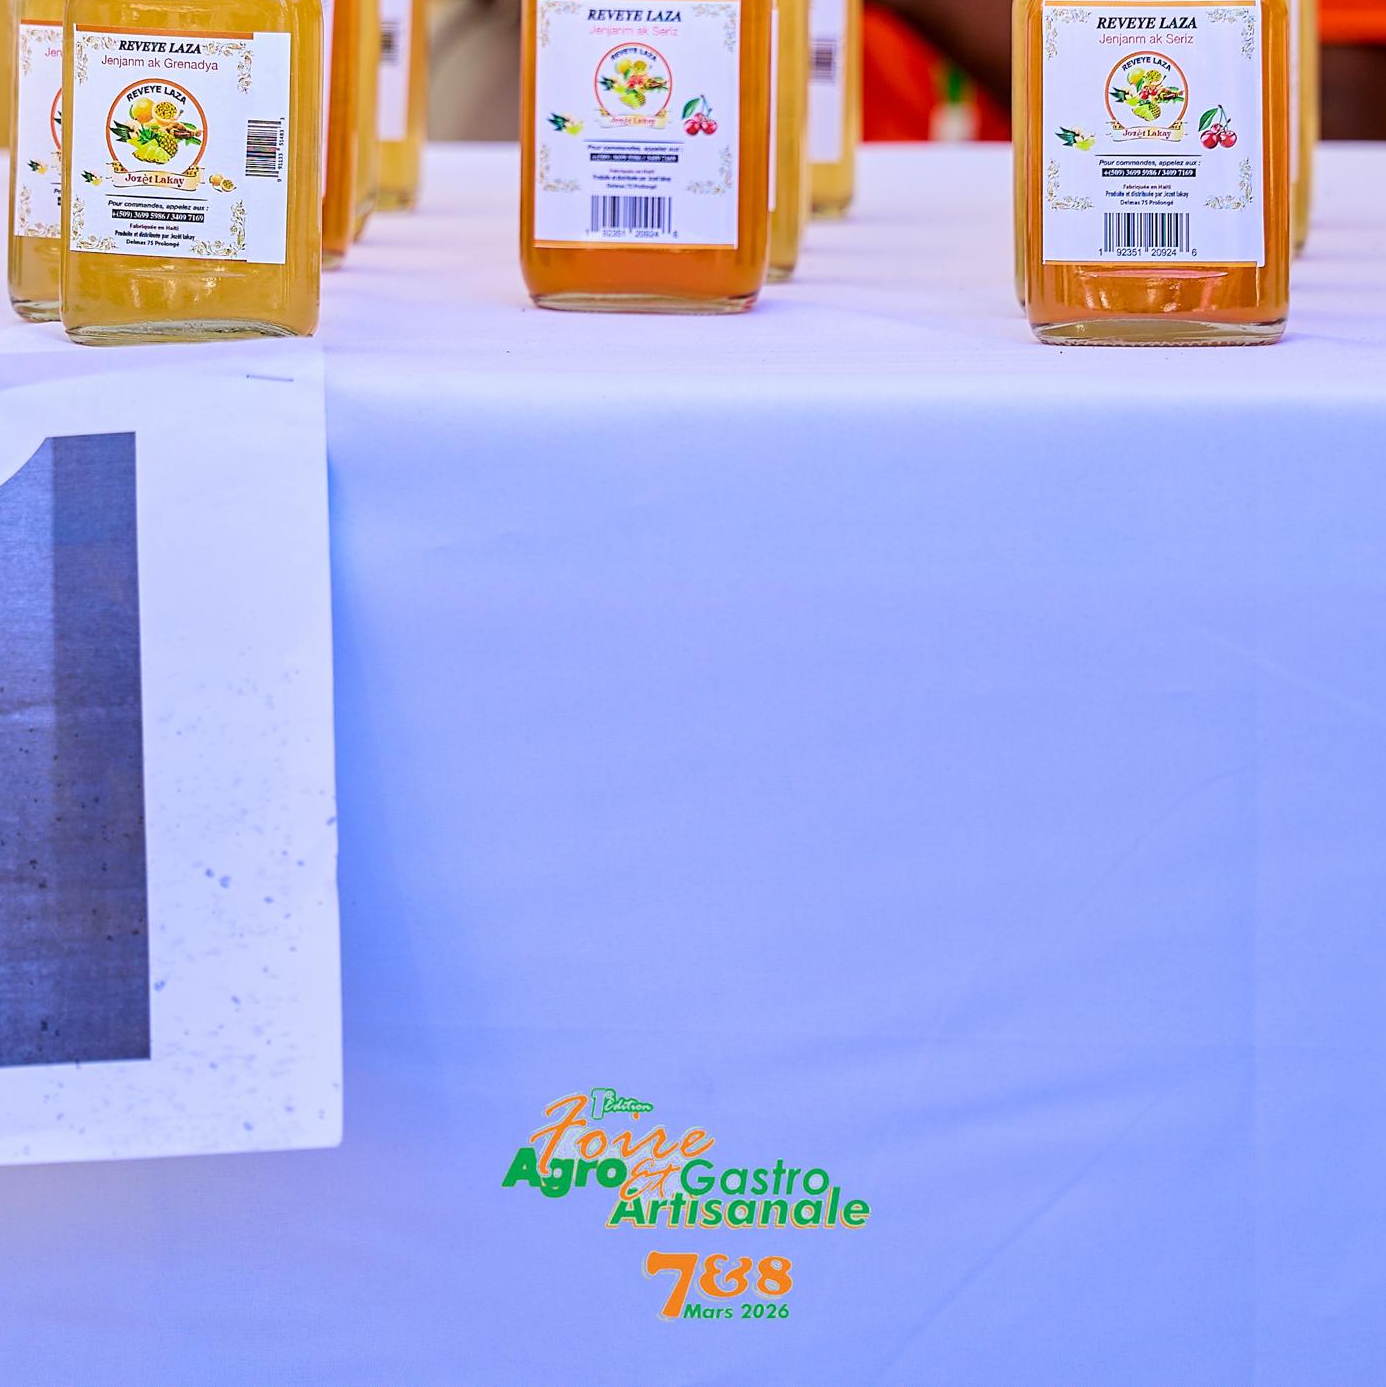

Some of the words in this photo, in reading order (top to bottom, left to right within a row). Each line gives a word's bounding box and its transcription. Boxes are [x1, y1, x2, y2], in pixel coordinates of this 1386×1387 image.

[587, 9, 643, 21] REVEYE
[646, 11, 682, 22] LAZA
[1096, 17, 1156, 29] REVEYE
[1159, 17, 1197, 29] LAZA
[1099, 34, 1146, 46] Jenjanm
[1149, 34, 1162, 44] ak
[1166, 34, 1193, 44] Seriz
[119, 40, 166, 53] REVEYE
[169, 42, 201, 55] LAZA
[101, 55, 145, 70] Jenjanm
[148, 58, 160, 68] ak
[164, 59, 219, 73] Grenadya
[1122, 57, 1151, 71] REVEYE
[1153, 58, 1171, 71] LAZA
[126, 85, 162, 103] REVEYE
[164, 86, 187, 105] LAZA
[155, 176, 184, 187] Lakay
[133, 211, 149, 219] 3699
[188, 213, 204, 222] 7169
